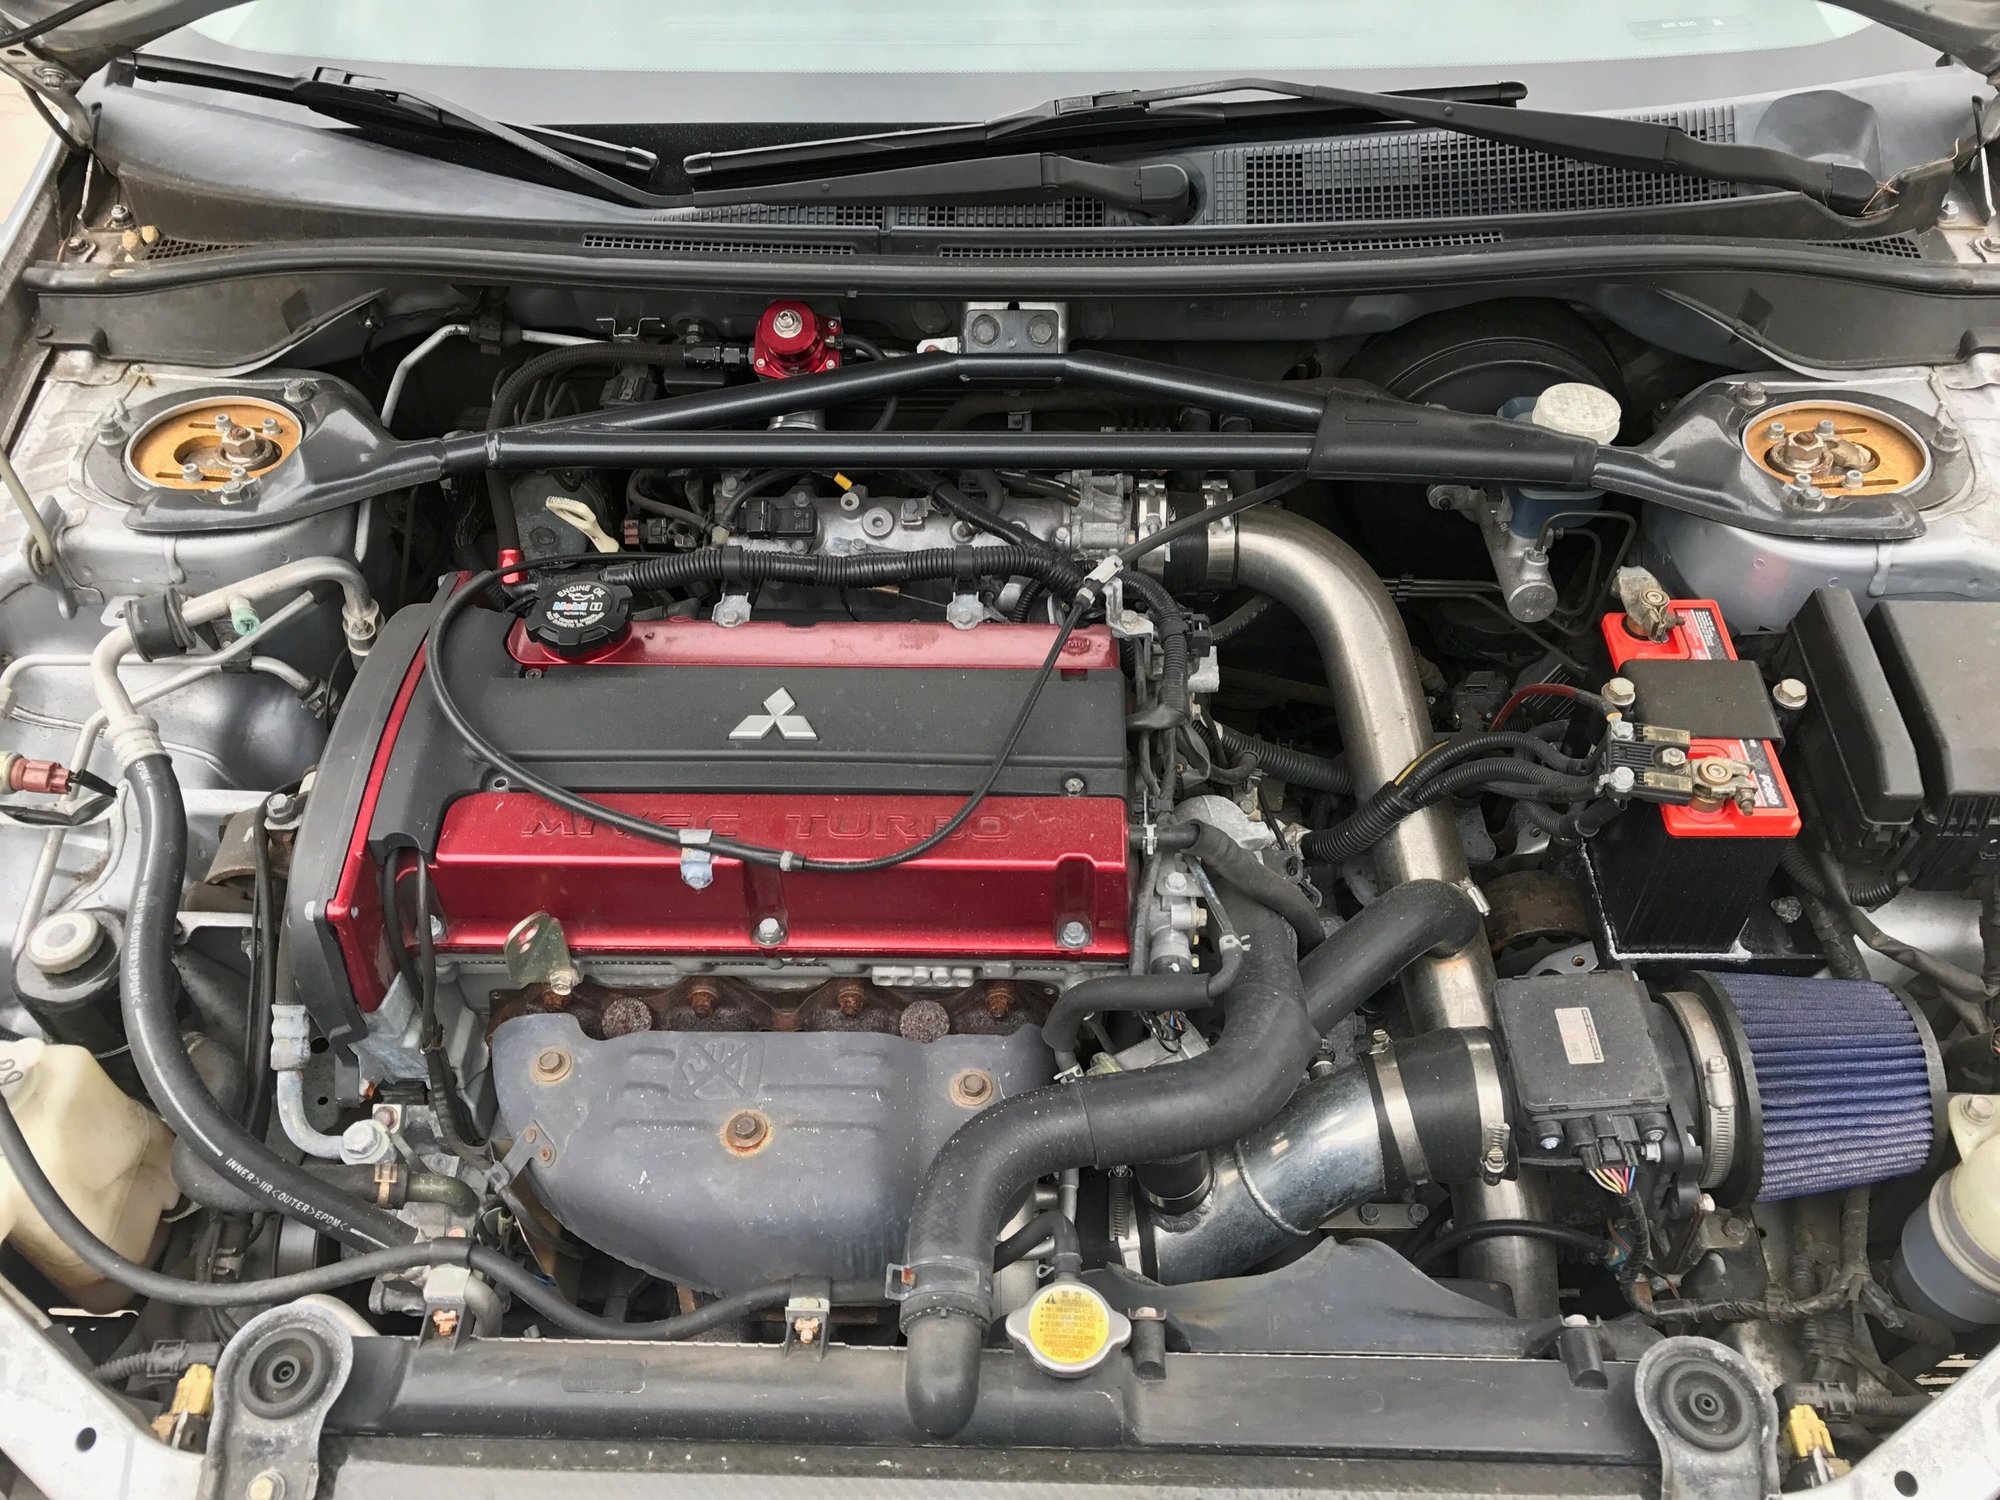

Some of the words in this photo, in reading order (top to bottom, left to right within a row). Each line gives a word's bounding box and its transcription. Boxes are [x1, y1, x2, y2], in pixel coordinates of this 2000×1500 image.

[556, 585, 591, 597] ENGINE
[593, 587, 606, 598] OIL
[552, 601, 588, 610] Mobil
[785, 811, 1013, 842] TURBO
